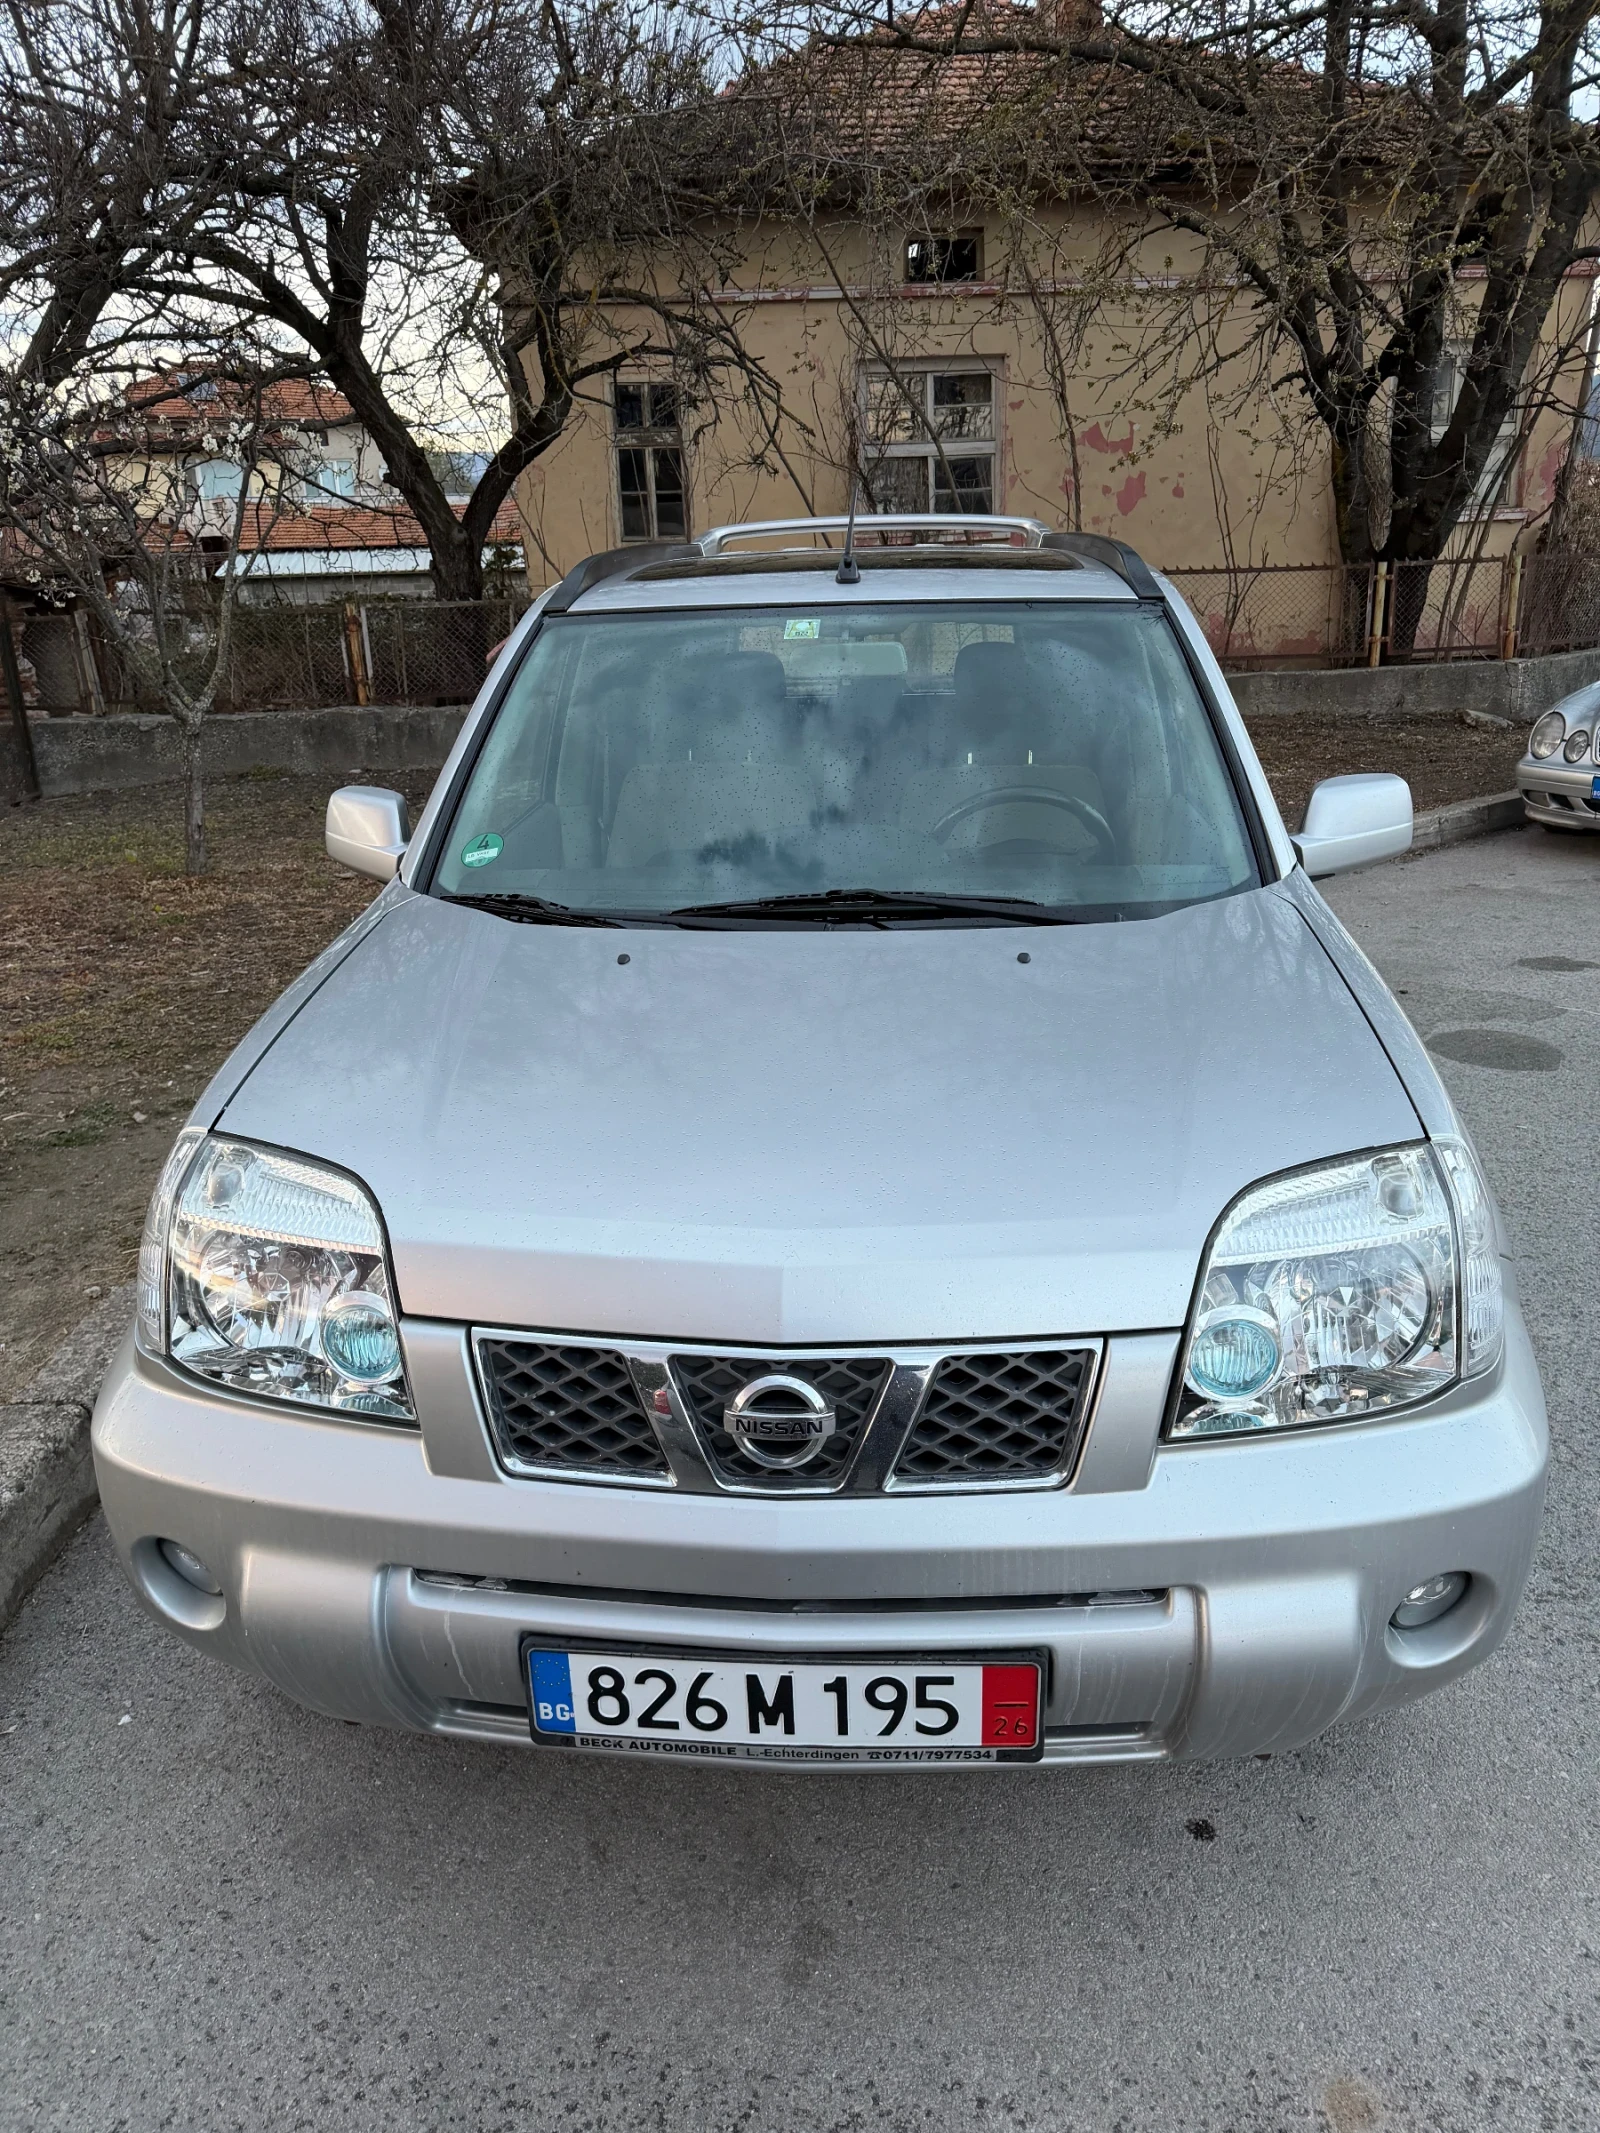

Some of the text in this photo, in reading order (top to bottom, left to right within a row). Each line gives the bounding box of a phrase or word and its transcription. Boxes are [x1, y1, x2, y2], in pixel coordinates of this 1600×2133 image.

[477, 834, 489, 849] 4
[735, 1419, 822, 1435] NISSAN
[587, 1666, 960, 1736] 826 M 195
[538, 1702, 571, 1722] BG
[994, 1715, 1028, 1736] 26
[580, 1737, 624, 1749] BECK
[629, 1738, 737, 1755] AUTOMOBILE
[746, 1746, 860, 1761] L.-Echterdingen
